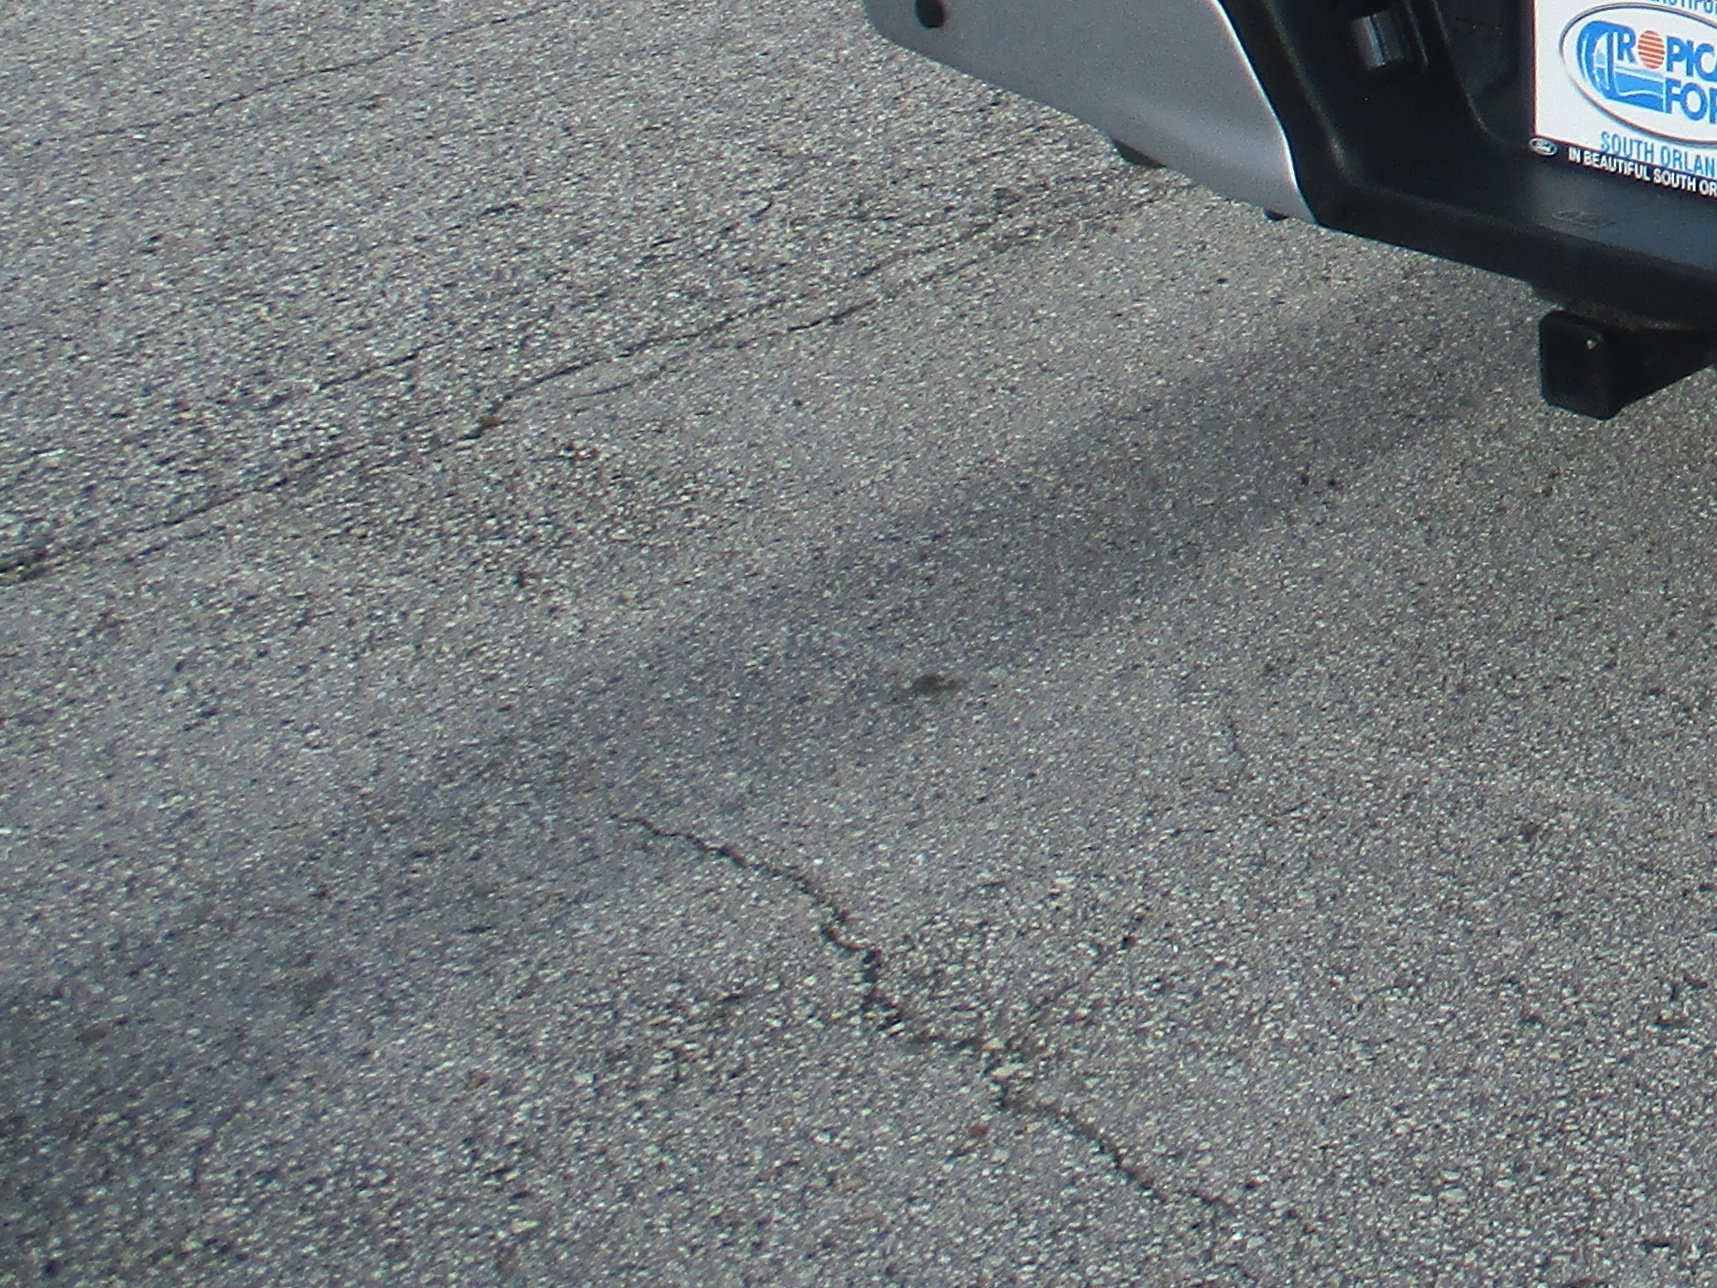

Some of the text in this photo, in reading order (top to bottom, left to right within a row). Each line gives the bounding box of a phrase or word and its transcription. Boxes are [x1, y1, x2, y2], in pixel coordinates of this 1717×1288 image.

[1600, 130, 1655, 164] SOUTH
[1567, 146, 1581, 164] IN
[1583, 150, 1651, 181] BEAUTIFUL
[1653, 168, 1697, 193] SOUTH
